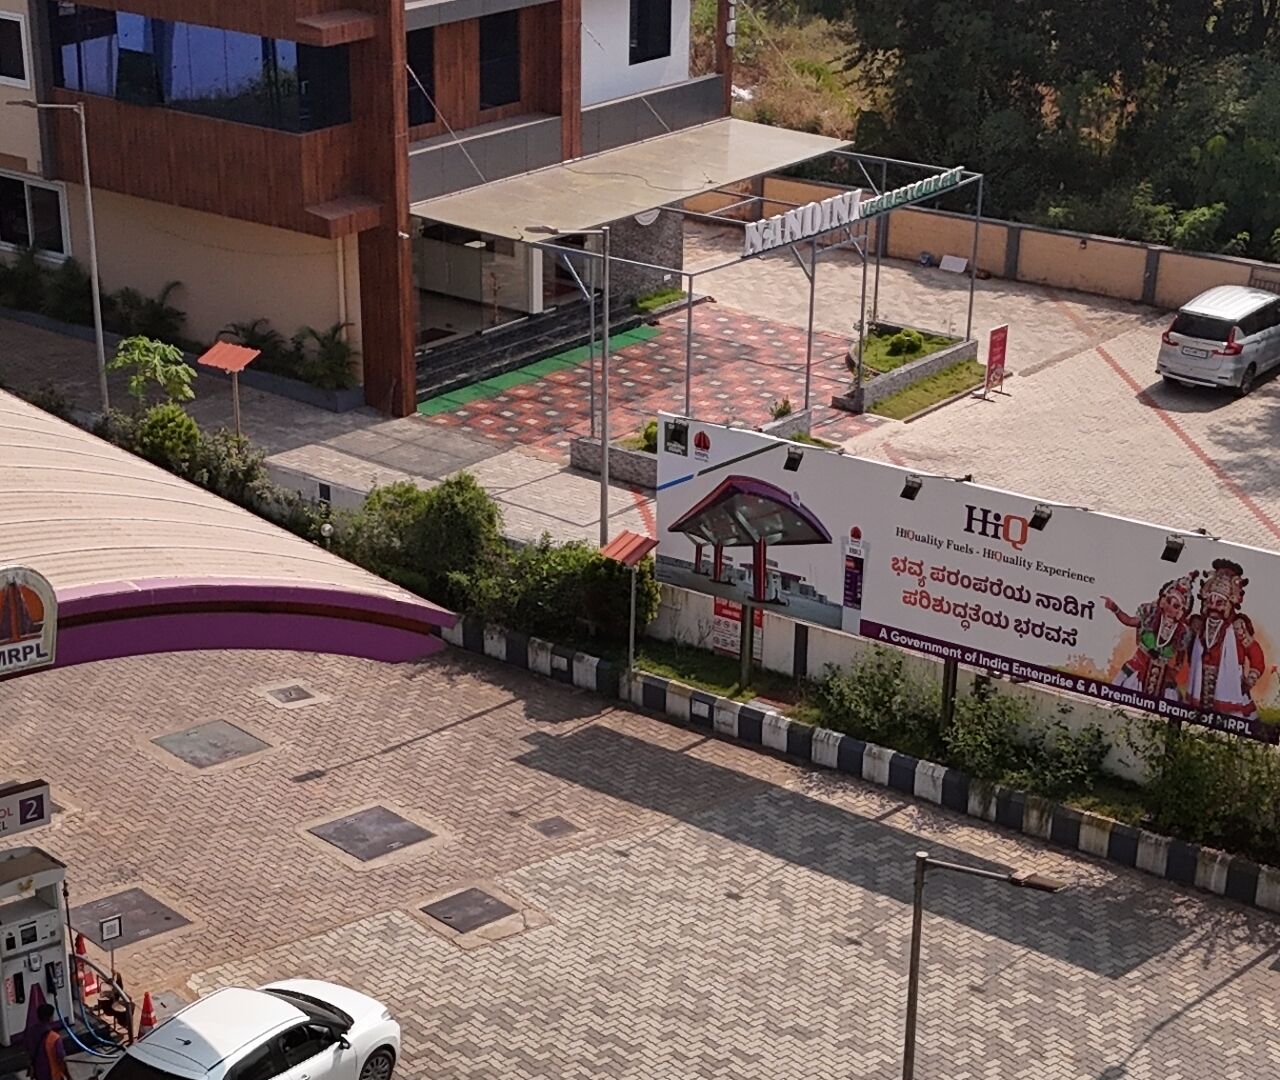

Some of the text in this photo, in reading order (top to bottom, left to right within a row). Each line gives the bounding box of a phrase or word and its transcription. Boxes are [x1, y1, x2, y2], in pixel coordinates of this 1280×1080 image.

[742, 188, 862, 257] NANDINI
[963, 504, 1028, 551] HiQ
[891, 555, 1095, 620] ಭವ್ಯ ಪರಂಪರೆಯ ನಾಡಿಗೆ
[946, 538, 974, 554] Fuels
[1035, 560, 1096, 585] Experience
[902, 589, 1078, 647] ಪರಿಶುದ್ಧತೆಯ ಭರವಸೆ
[879, 627, 888, 640] A
[890, 632, 962, 660] Government
[964, 651, 978, 664] of
[979, 653, 1009, 672] India
[1012, 662, 1074, 688] Enterprise
[1076, 679, 1086, 691] &
[1088, 682, 1098, 694] A
[1100, 686, 1155, 710] Premium
[25, 799, 38, 820] 2
